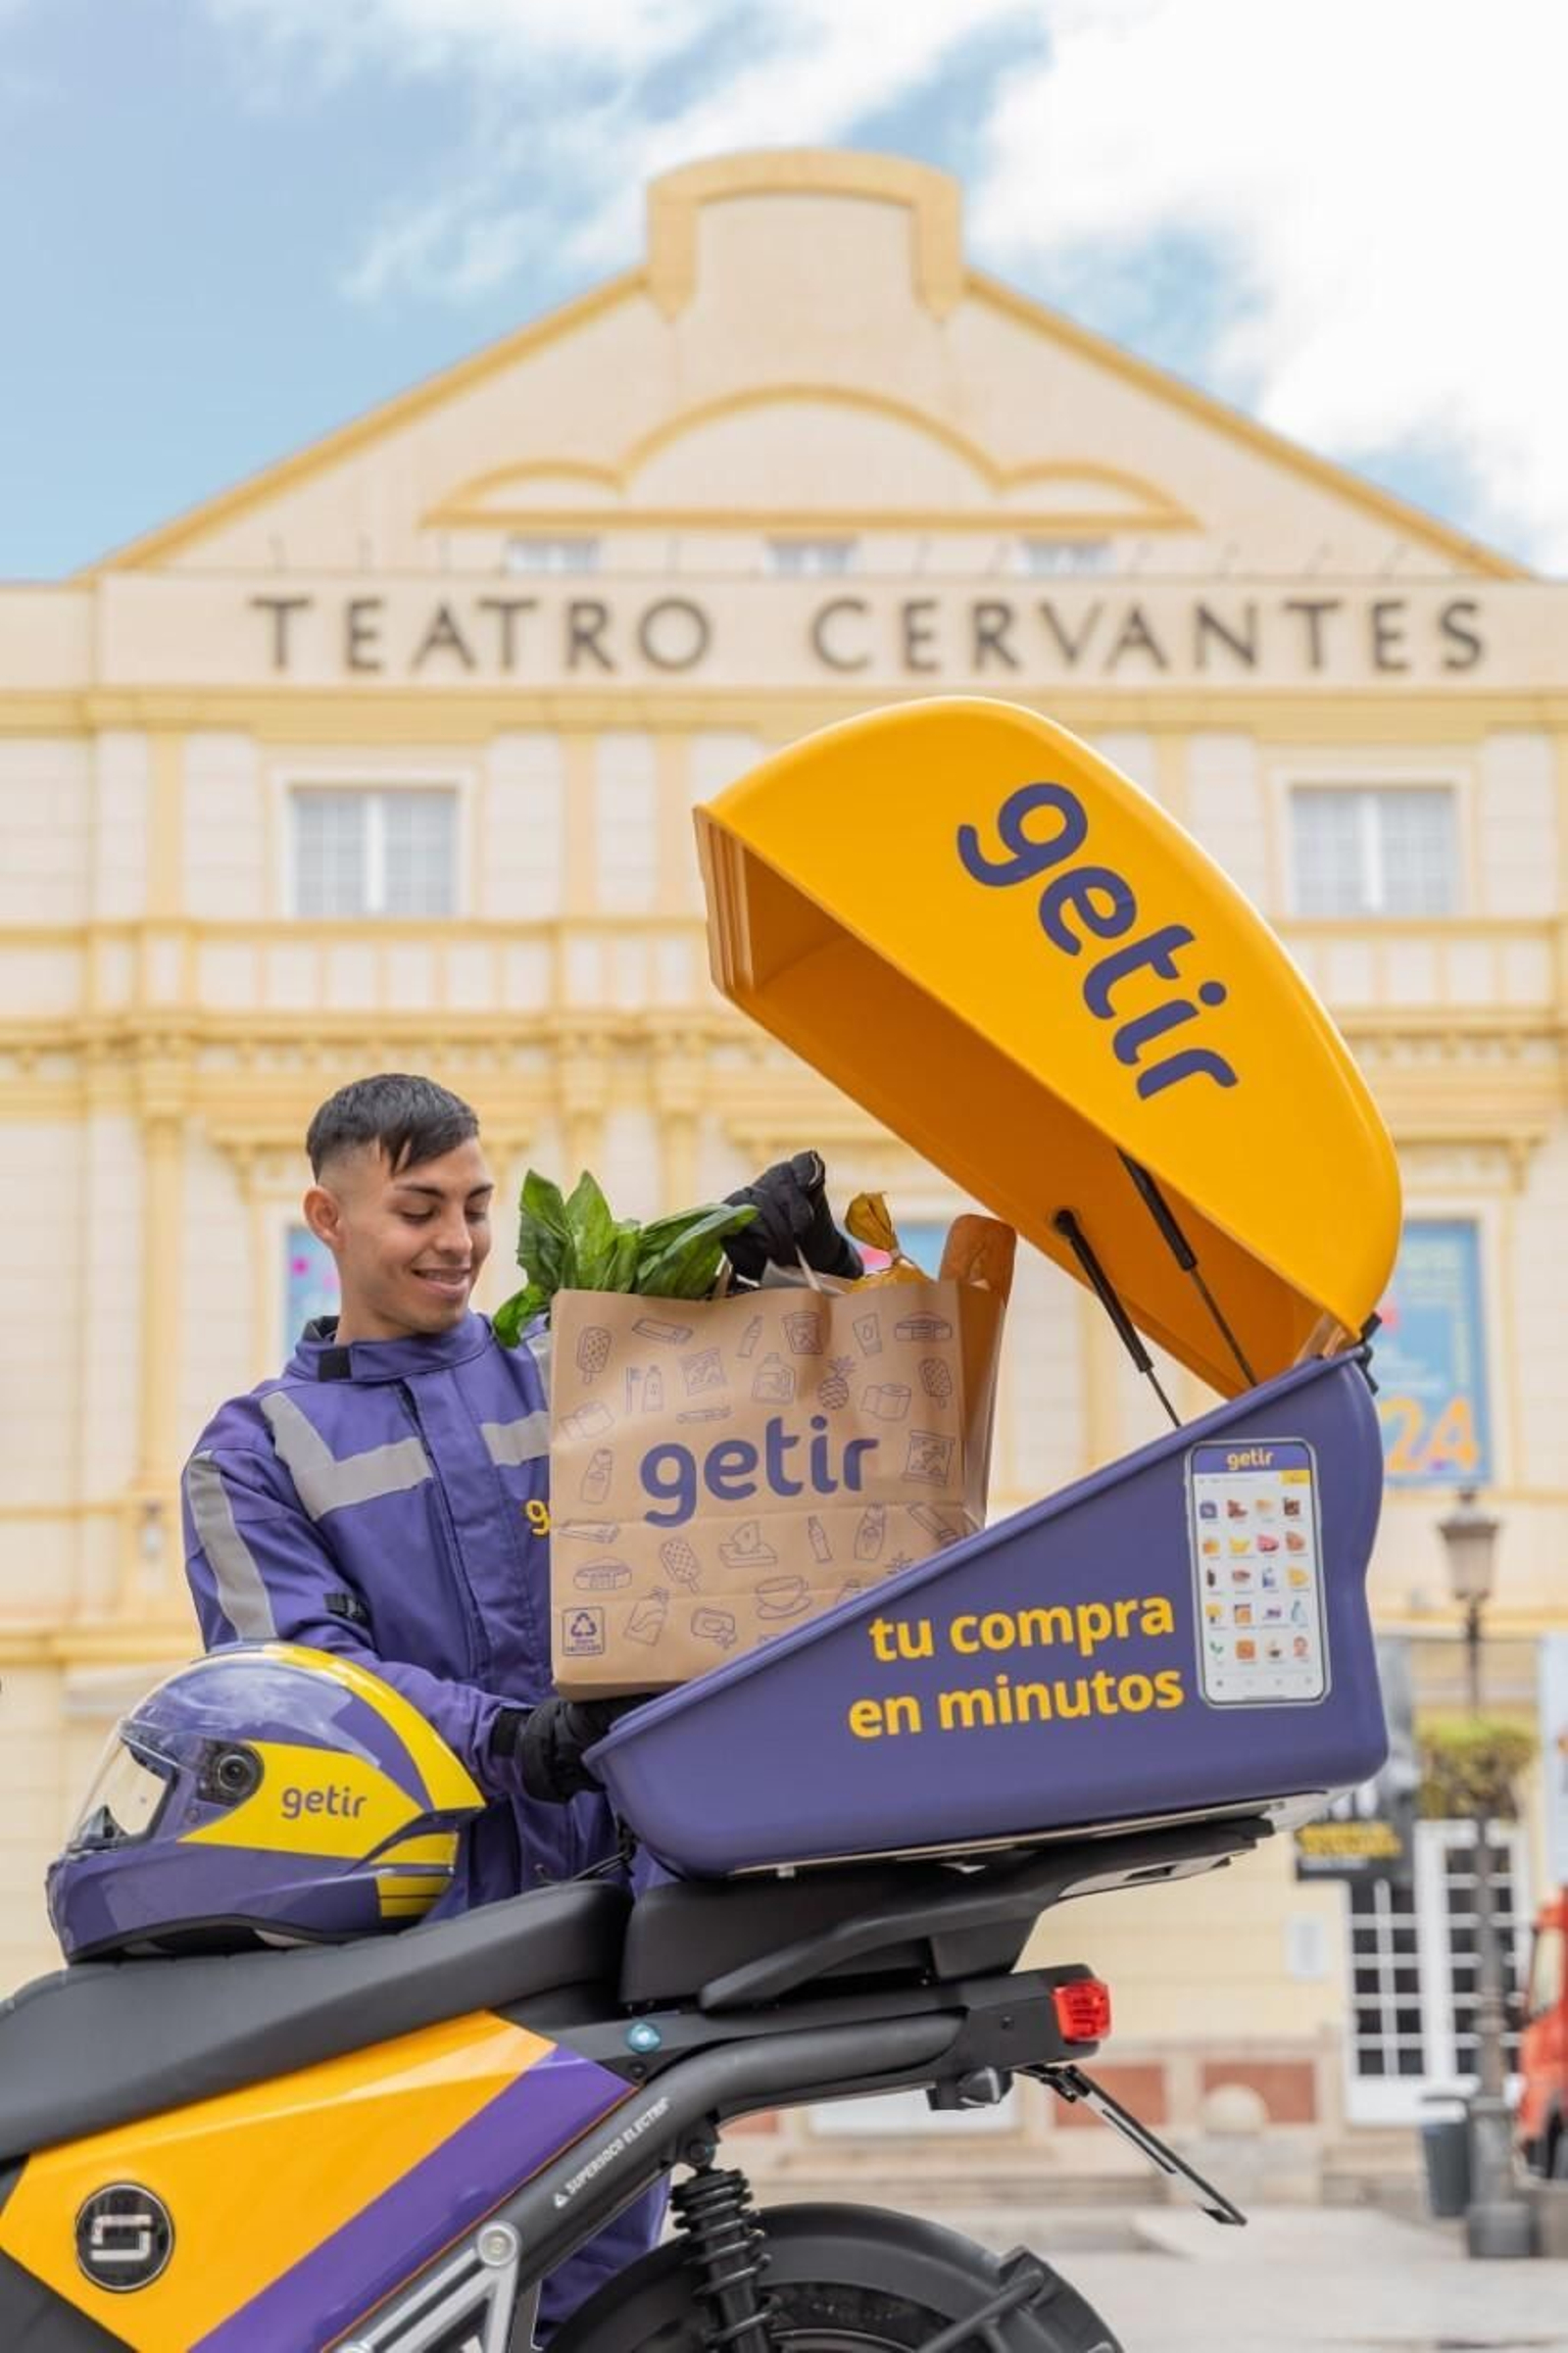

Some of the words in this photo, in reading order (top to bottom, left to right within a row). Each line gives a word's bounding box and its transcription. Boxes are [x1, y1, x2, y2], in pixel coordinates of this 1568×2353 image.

[249, 597, 713, 674] TEATRO
[808, 599, 1485, 674] CERVANTES
[956, 781, 1240, 1102] getir
[640, 1414, 880, 1528] getir
[1226, 1447, 1273, 1471] getir
[869, 1617, 934, 1661] tu
[949, 1595, 1175, 1656] compra
[848, 1695, 922, 1738] en
[938, 1669, 1185, 1730] minutos
[280, 1784, 368, 1820] getir
